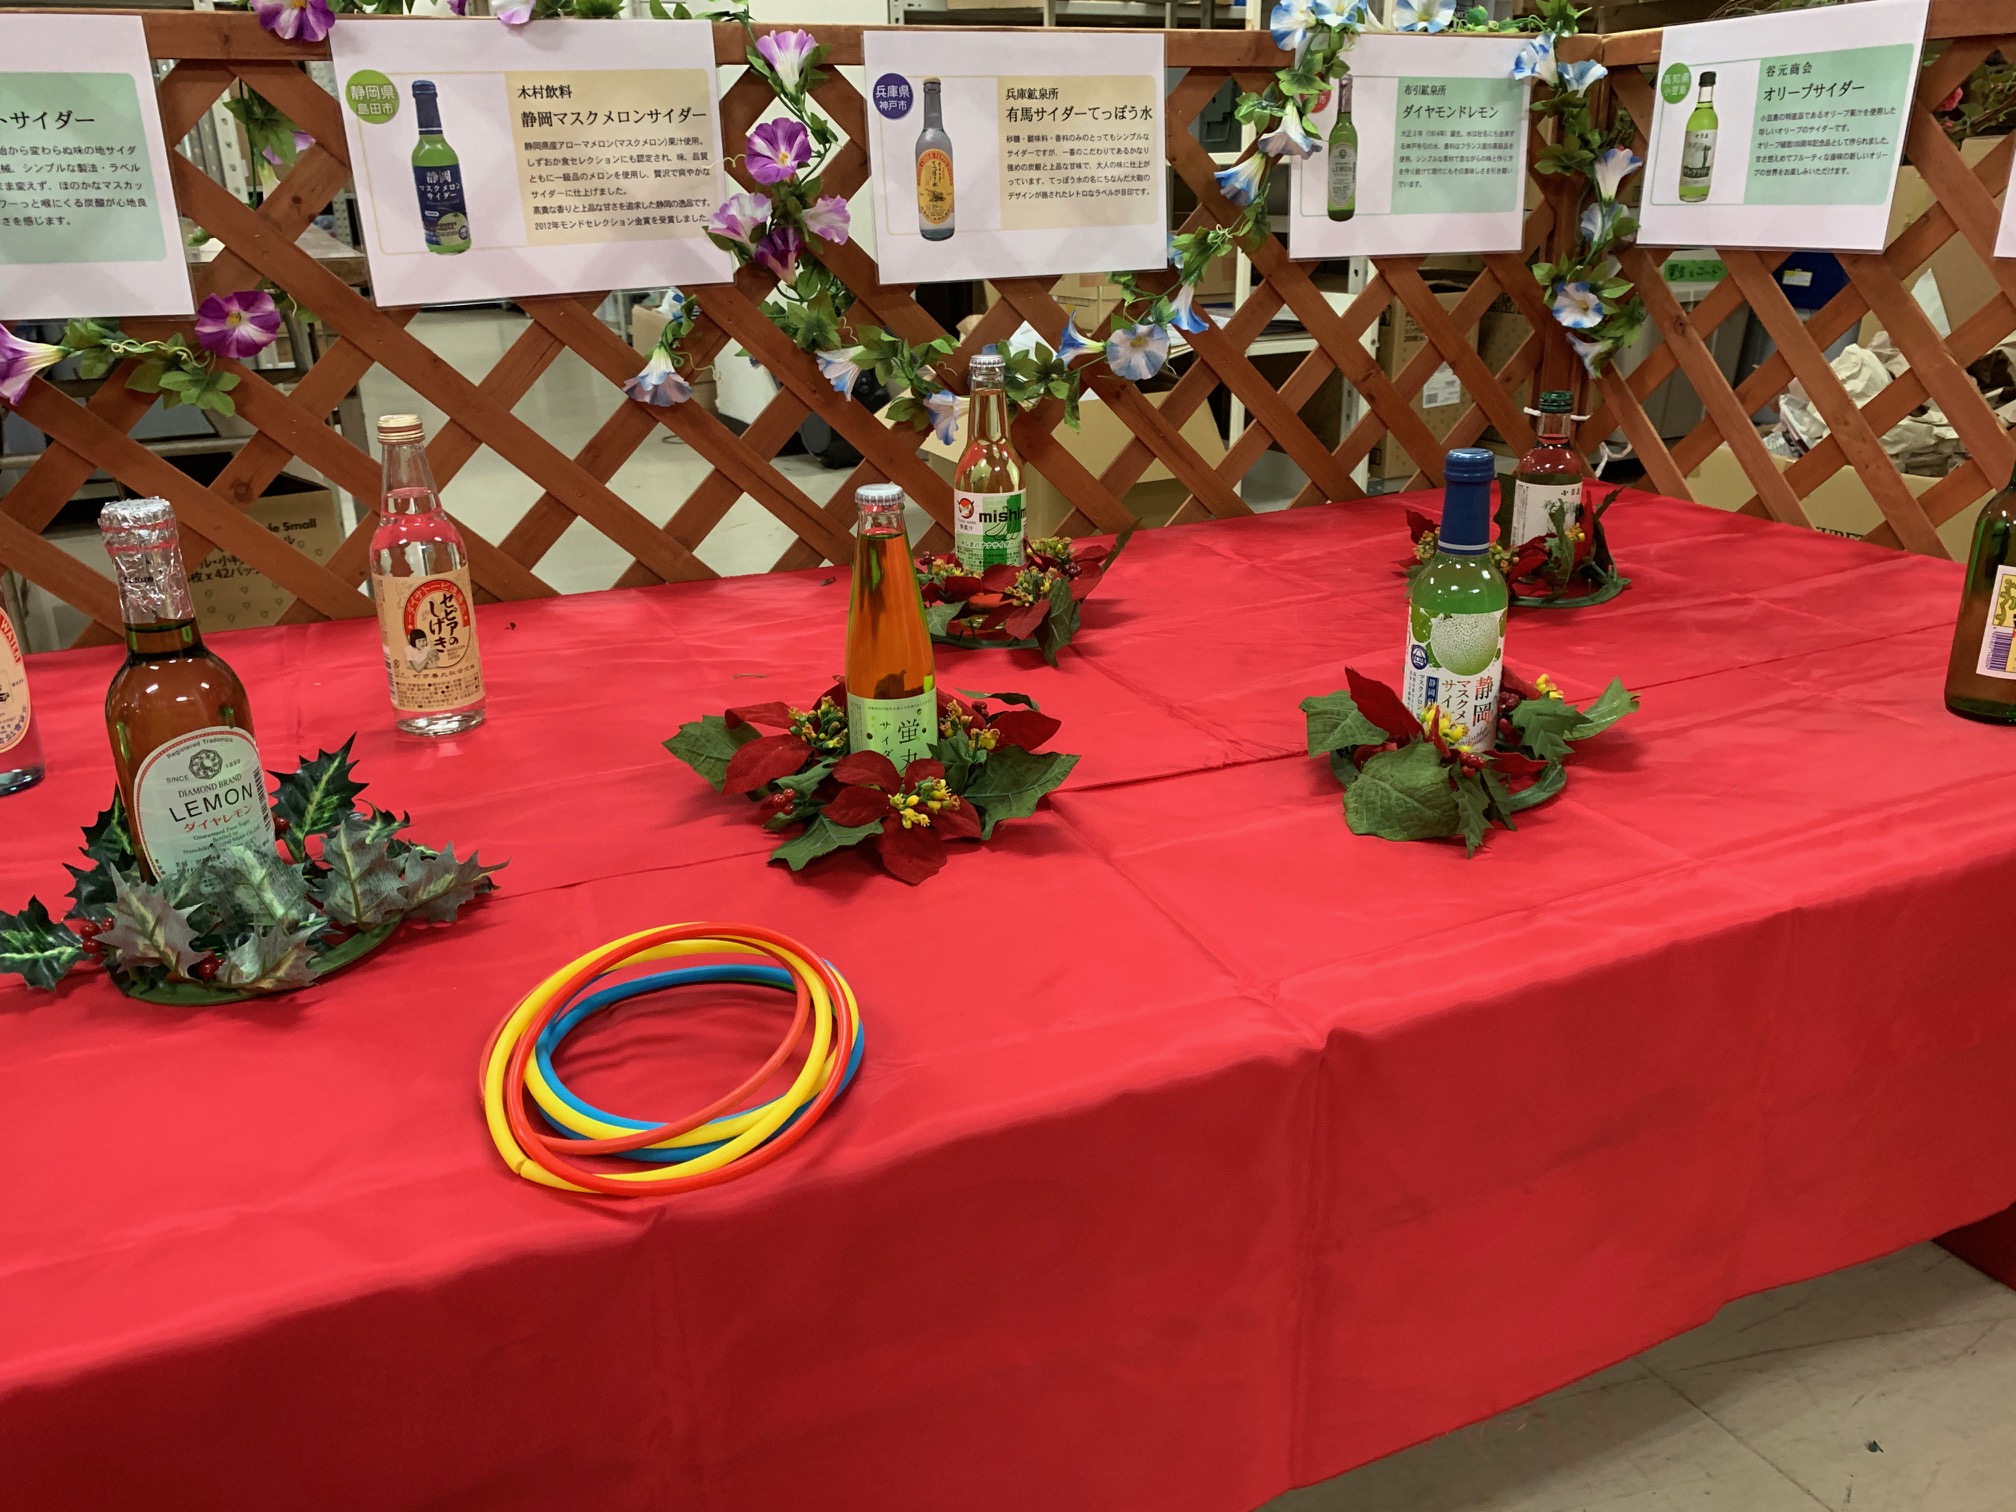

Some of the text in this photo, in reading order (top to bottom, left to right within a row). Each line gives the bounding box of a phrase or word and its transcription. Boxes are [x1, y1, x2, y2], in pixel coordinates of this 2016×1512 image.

[1766, 62, 1813, 77] 谷元商会
[350, 85, 396, 100] 静岡県
[517, 84, 572, 100] 木村飲料
[875, 85, 910, 98] 兵庫県
[1763, 80, 1865, 101] オリーブサイダー
[357, 103, 394, 115] 島田市
[879, 100, 908, 111] 神戸市
[1402, 104, 1499, 119] ダイヤモンドレモン
[521, 107, 707, 128] 静岡マスクメロンサイダー
[1006, 105, 1153, 122] 有馬サイダーてっぽう水
[0, 163, 140, 173] 械、シンプルな製法・ラベル
[426, 170, 452, 183] 静岡
[0, 181, 143, 191] ま変えず、ほのかなマスカッ
[419, 182, 461, 192] マスクメロン
[426, 192, 458, 200] サイダー
[283, 518, 317, 532] Small
[428, 600, 447, 653] しげき
[440, 593, 459, 645] セピアの
[1455, 679, 1472, 724] マスクメ
[1472, 675, 1494, 727] 静岡
[166, 736, 234, 760] Registered Trademark
[166, 774, 189, 784] SINCE
[178, 773, 242, 799] DIAMOND BRAND
[168, 782, 253, 823] LEMON
[183, 804, 253, 834] ダイヤレモン
